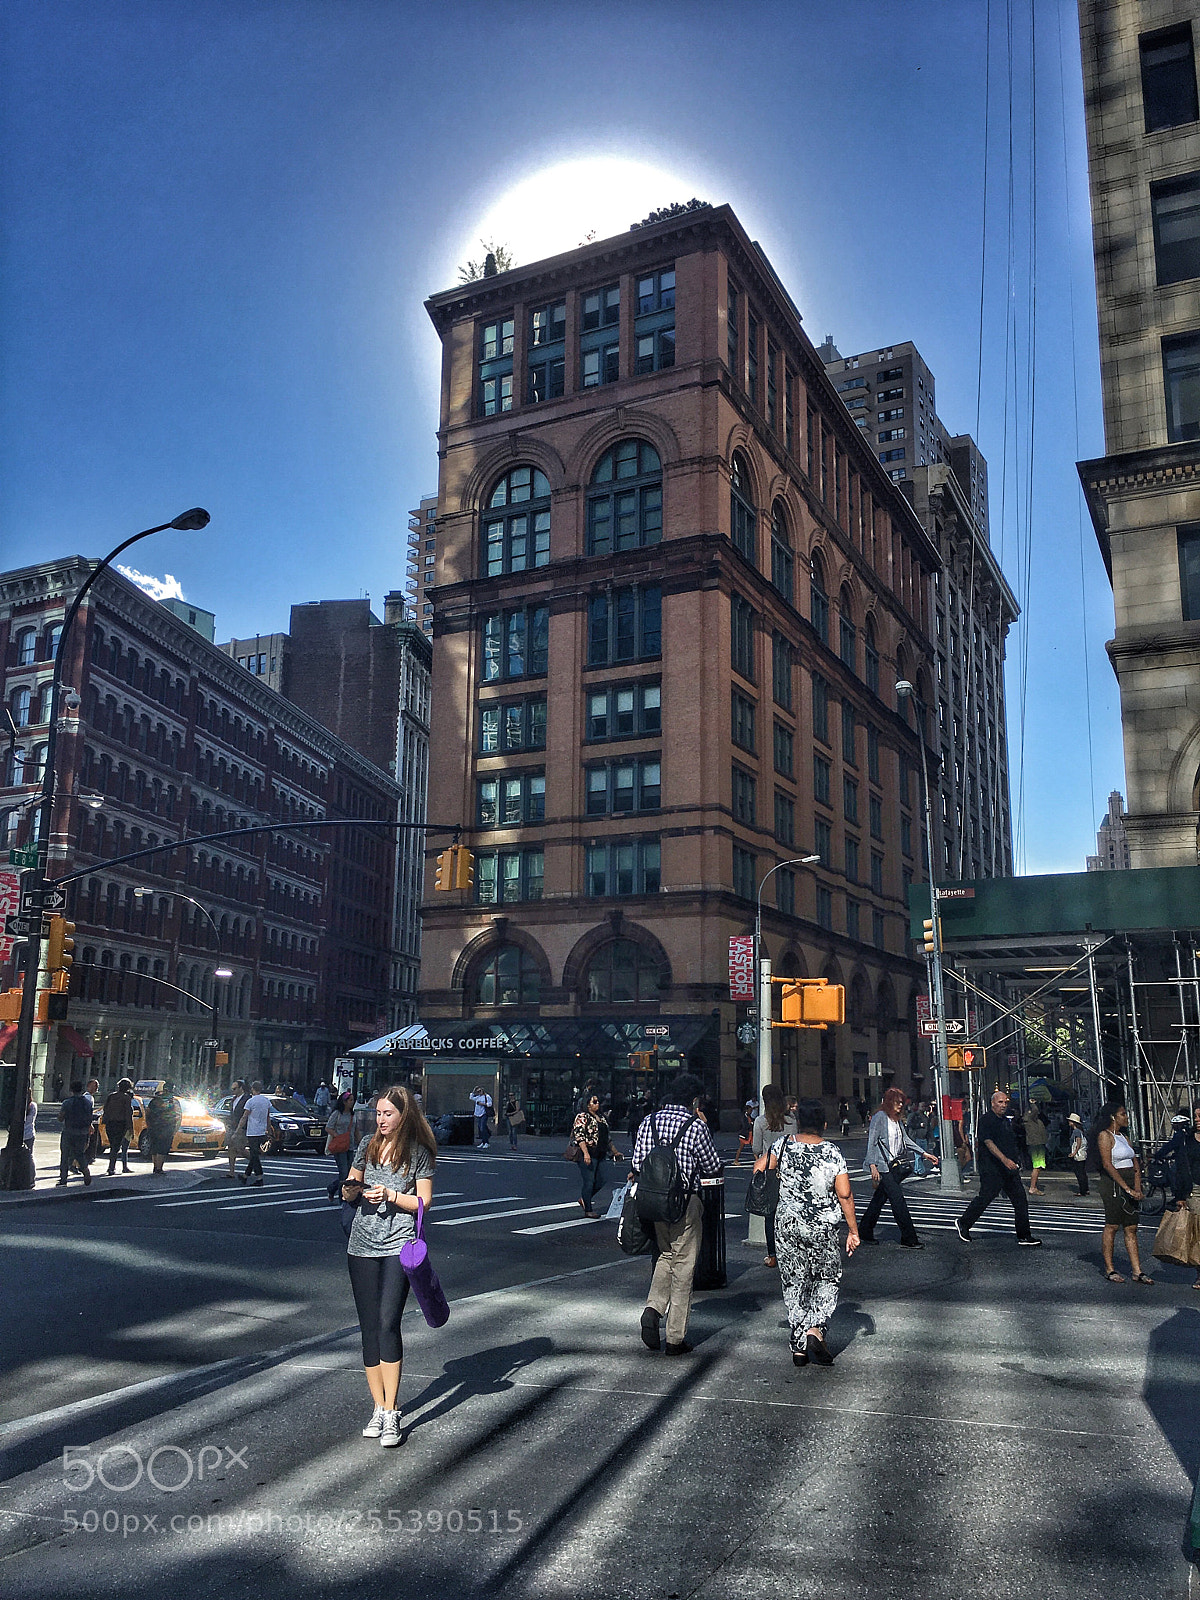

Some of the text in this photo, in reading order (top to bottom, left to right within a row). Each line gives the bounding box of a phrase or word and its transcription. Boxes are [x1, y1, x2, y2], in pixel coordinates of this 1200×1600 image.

[939, 889, 966, 897] Lafayette
[12, 921, 26, 930] ONE
[734, 942, 748, 995] ASTOR
[385, 1038, 504, 1050] STARBUCKS COFFEE
[336, 1066, 354, 1078] Fed
